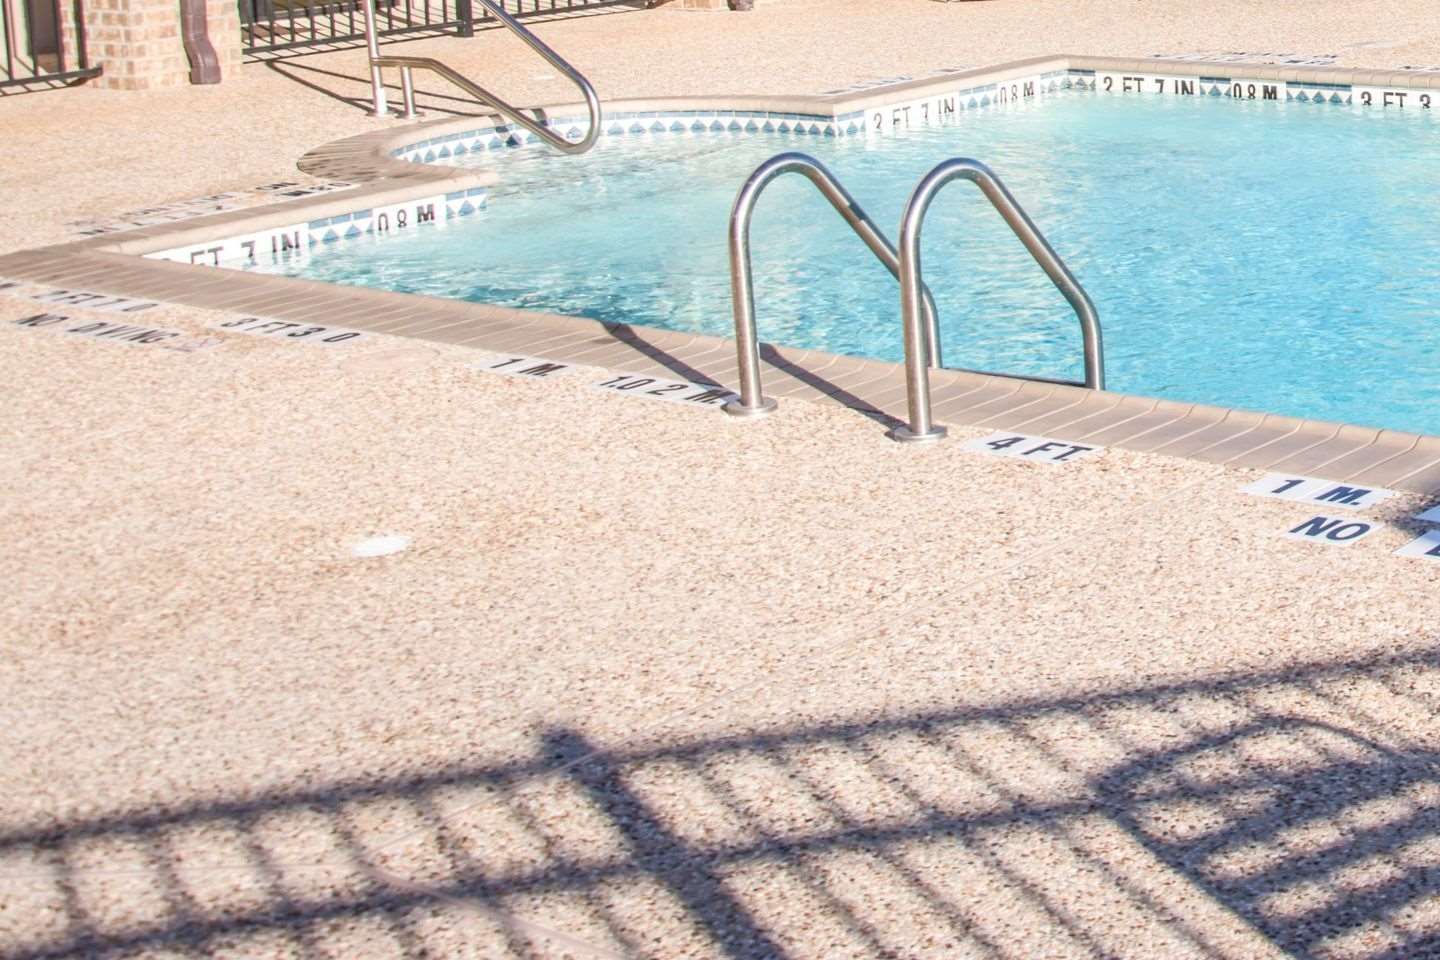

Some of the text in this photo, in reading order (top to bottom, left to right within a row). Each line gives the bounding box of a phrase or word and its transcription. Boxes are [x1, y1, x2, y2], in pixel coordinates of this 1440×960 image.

[1122, 77, 1144, 92] FT
[1155, 79, 1165, 94] 7
[1174, 79, 1194, 95] IN
[1383, 92, 1407, 107] FT
[271, 231, 299, 252] IN
[243, 321, 301, 334] FT
[287, 327, 327, 338] 3
[490, 358, 525, 368] 1
[986, 436, 1025, 451] 4
[1270, 478, 1305, 494] 1
[1288, 515, 1373, 542] NO
